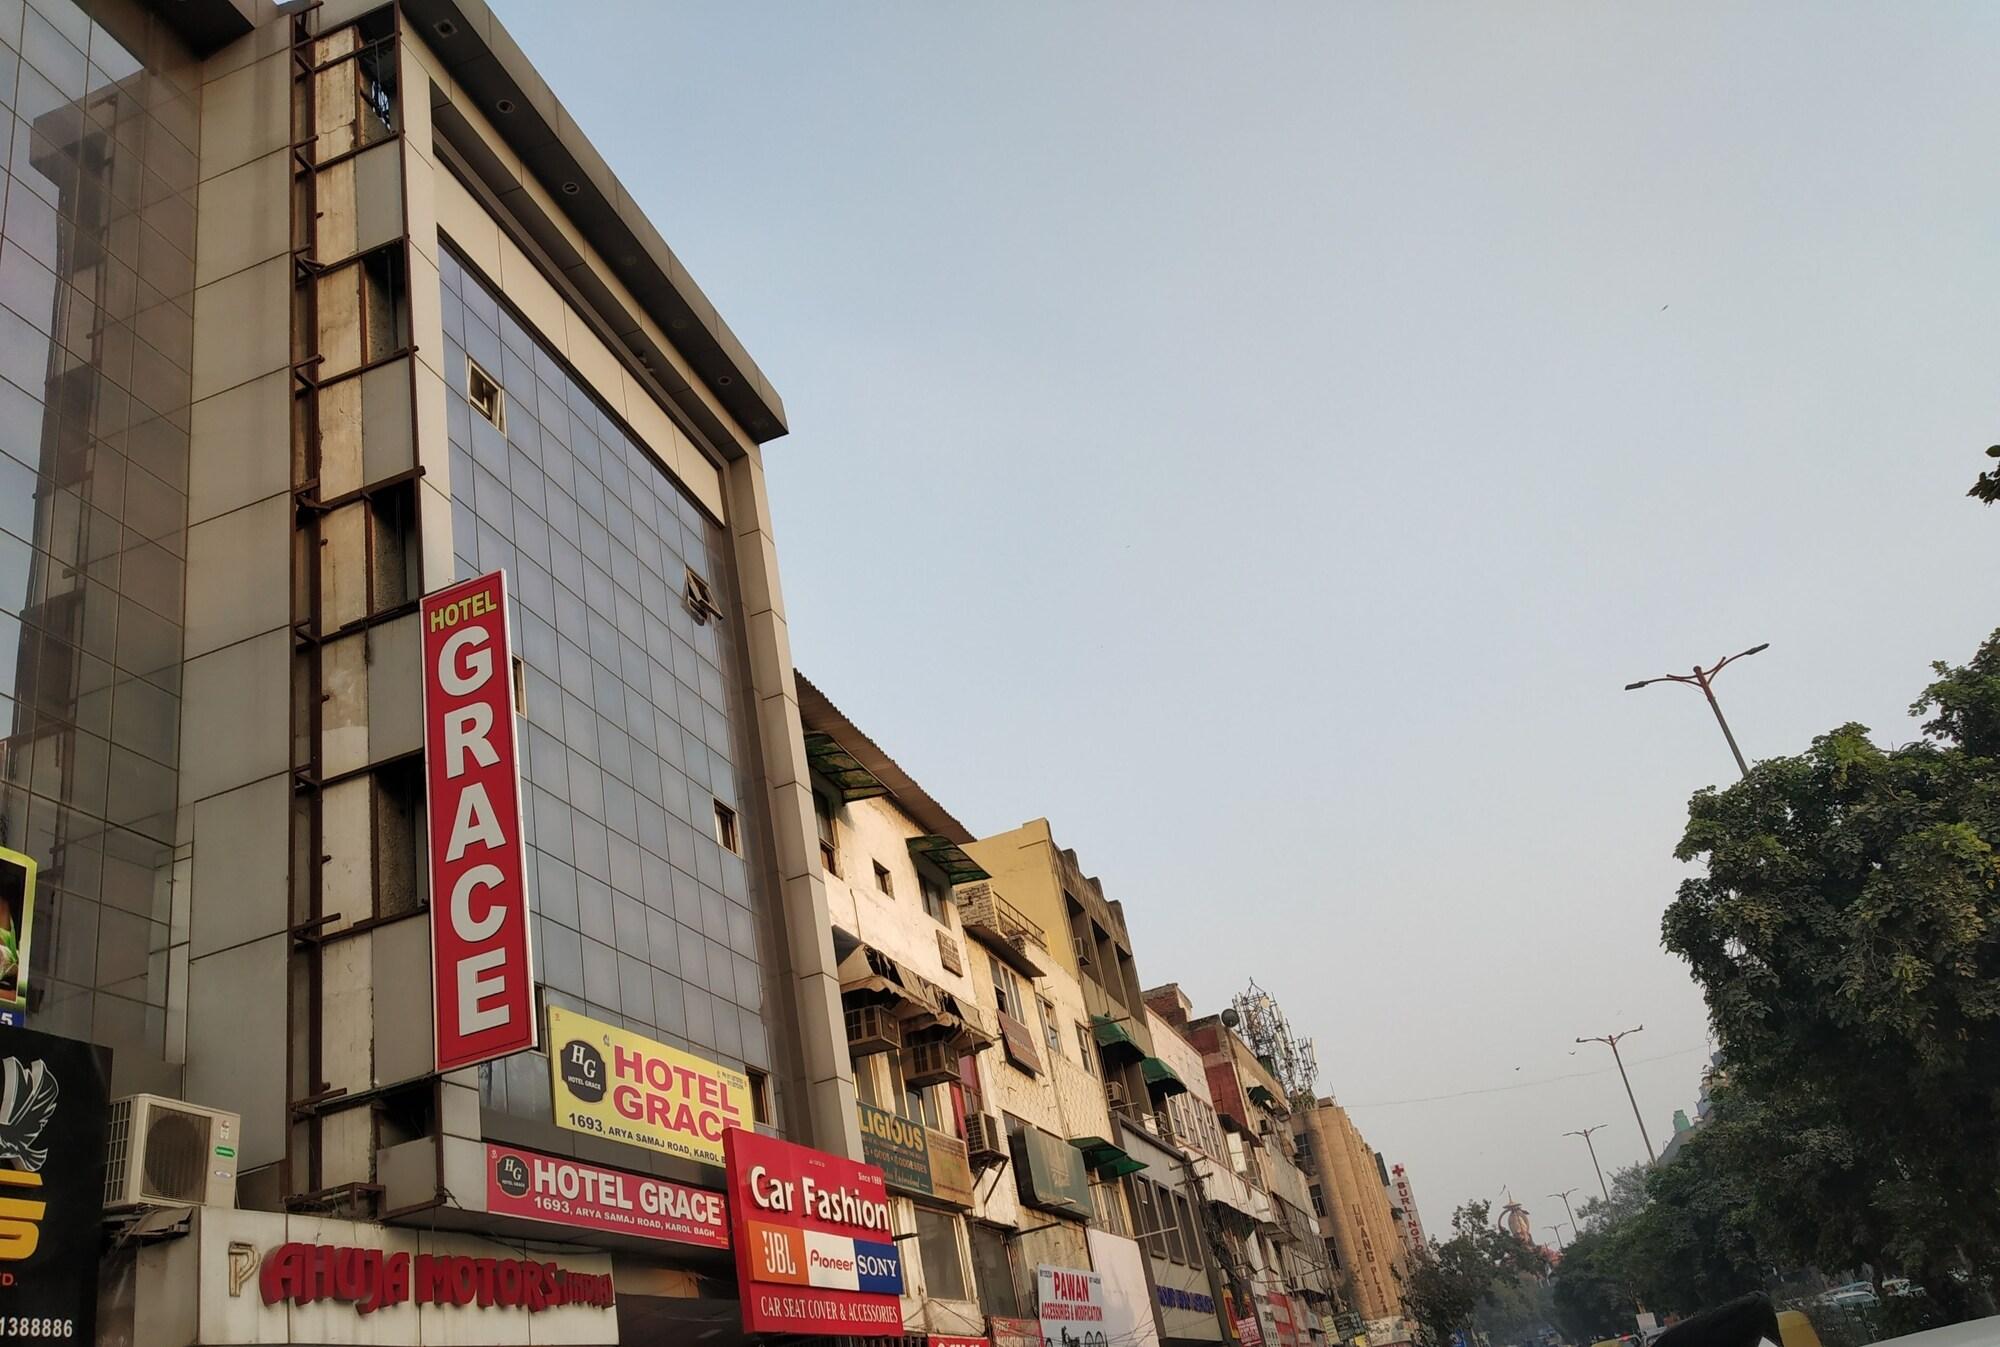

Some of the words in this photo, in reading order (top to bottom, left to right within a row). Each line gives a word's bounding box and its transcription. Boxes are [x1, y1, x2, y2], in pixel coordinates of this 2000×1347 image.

[430, 590, 497, 633] HOTEL
[437, 624, 511, 1037] GRACE
[567, 1075, 585, 1086] HOTEL
[584, 1079, 601, 1090] GRACE
[614, 1045, 740, 1115] HOTEL
[568, 1112, 606, 1135] 1693,
[608, 1126, 633, 1140] ARYA
[635, 1133, 665, 1148] SAMAJ
[667, 1141, 692, 1157] ROAD,
[693, 1148, 719, 1162] KAROL
[534, 1159, 633, 1210] HOTEL
[639, 1182, 722, 1226] GRACE
[751, 1166, 795, 1212] Car
[802, 1176, 889, 1230] Fashion
[534, 1196, 573, 1216] 1693,
[575, 1207, 602, 1220] ARYA
[604, 1212, 635, 1225] SAMAJ
[637, 1217, 664, 1231] ROAD,
[665, 1221, 692, 1234] KAROL
[693, 1227, 715, 1238] BAGH
[764, 1231, 796, 1275] JBL
[810, 1249, 854, 1272] Pioneer
[857, 1254, 897, 1277] SONY
[259, 1242, 410, 1316] AHUJA
[414, 1254, 558, 1312] MOTORS
[1053, 1271, 1090, 1302] PAWAN
[761, 1295, 782, 1317] CAR
[783, 1298, 806, 1319] SEAT
[808, 1300, 838, 1321] COVER
[839, 1303, 847, 1321] &
[848, 1303, 898, 1323] ACCESSORIES
